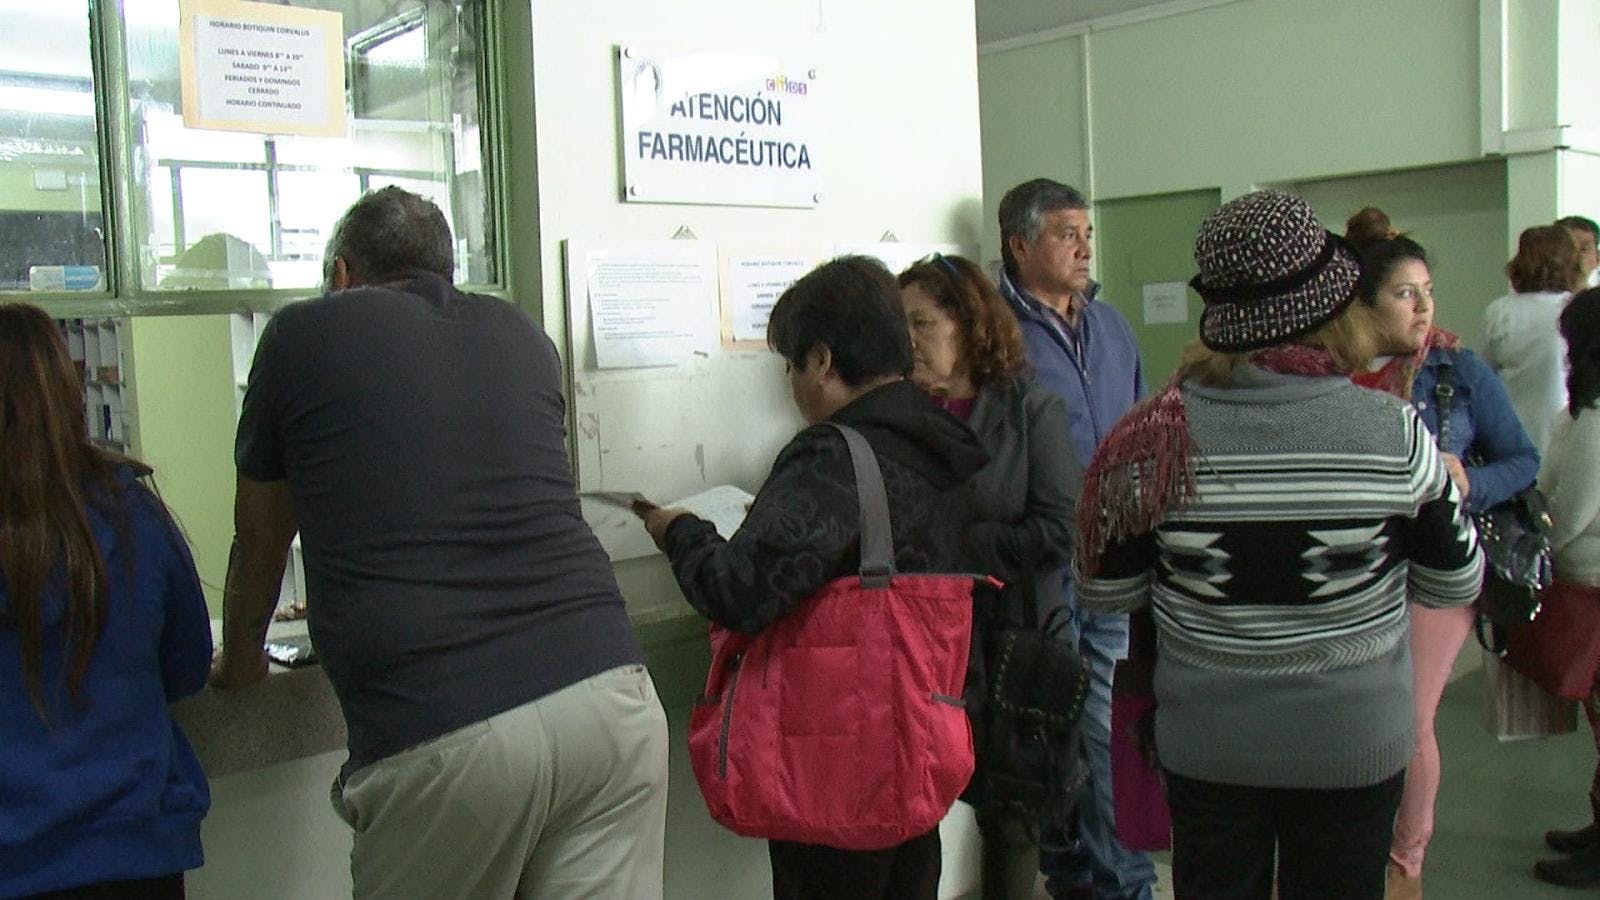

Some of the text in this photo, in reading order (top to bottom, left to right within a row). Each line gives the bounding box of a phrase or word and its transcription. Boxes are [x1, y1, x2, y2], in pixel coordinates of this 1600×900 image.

[209, 21, 241, 30] HORARIO
[217, 47, 239, 56] LUNES
[246, 49, 274, 59] VIERNES
[224, 74, 258, 83] FERIADOS
[263, 77, 301, 86] DOMINGOS
[248, 86, 280, 95] CERRADO
[225, 98, 302, 110] HORARIO CONTINUADO
[670, 91, 782, 126] ATENCIÓN
[638, 131, 812, 170] FARMACÉUTICA
